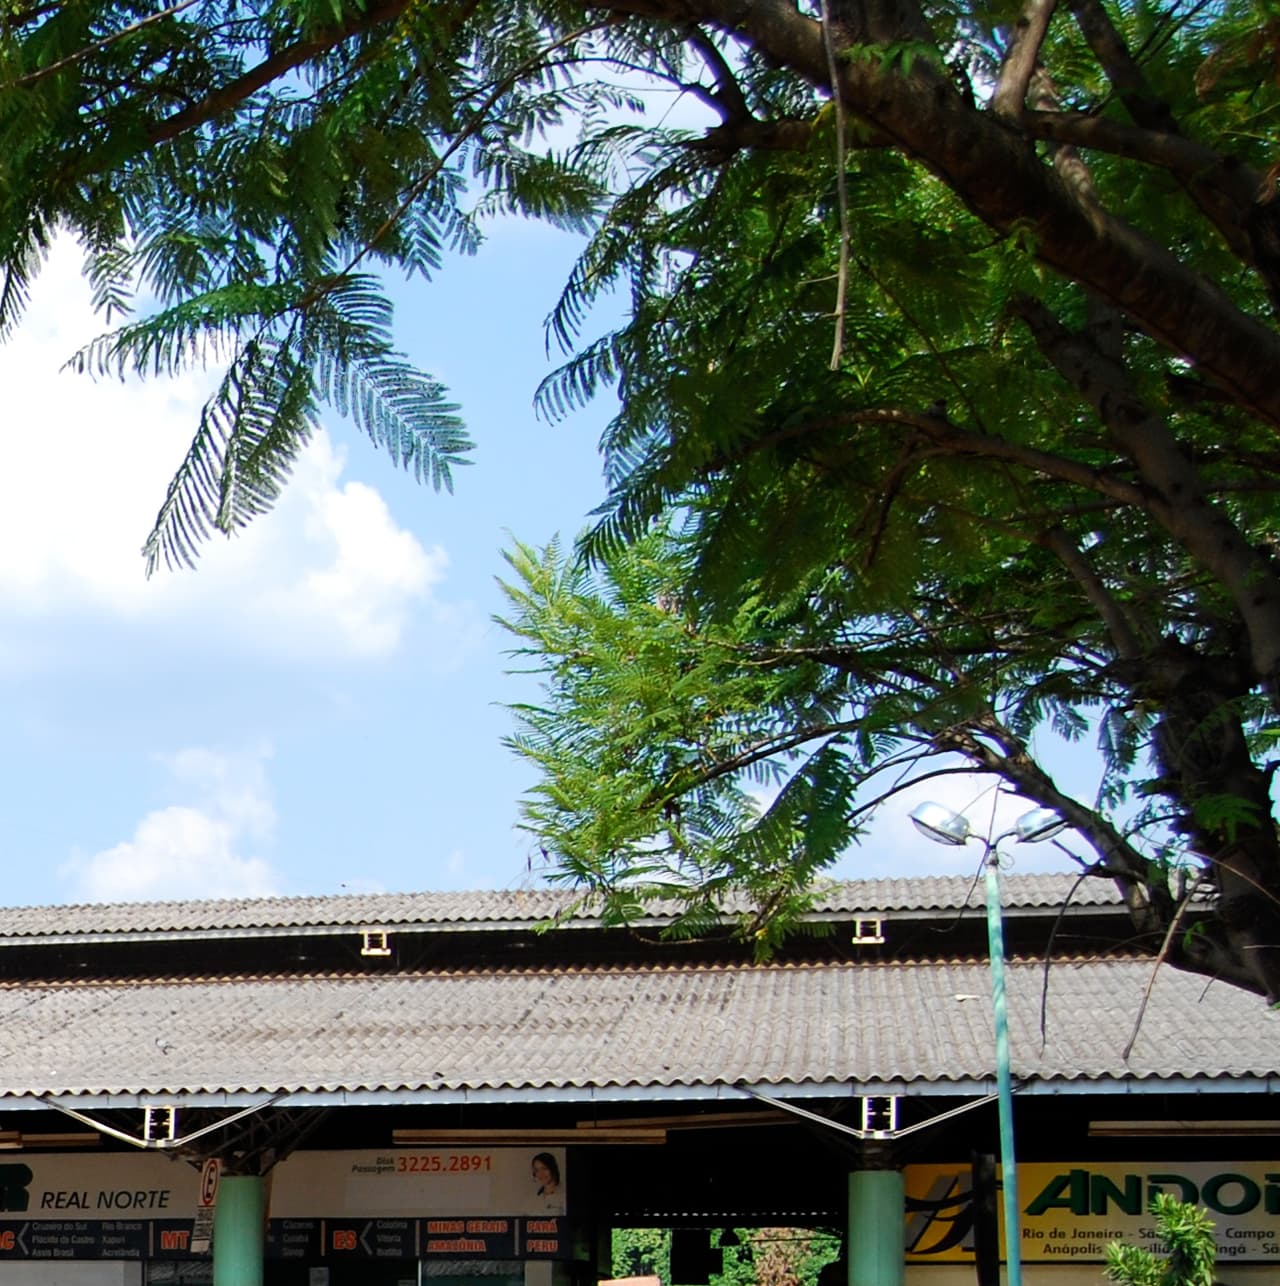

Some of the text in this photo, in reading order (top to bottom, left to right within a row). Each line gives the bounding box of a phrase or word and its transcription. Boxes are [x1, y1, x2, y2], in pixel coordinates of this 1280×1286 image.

[398, 1155, 493, 1173] 3225.2891
[40, 1189, 171, 1210] REAL NORTE
[427, 1220, 509, 1234] MINAS GERAIS
[526, 1218, 559, 1234] PARÁ
[161, 1230, 190, 1250] MT
[333, 1230, 358, 1250] ES
[1022, 1227, 1046, 1239] Rio
[1048, 1227, 1066, 1239] de
[1070, 1227, 1123, 1239] Janeiro
[1225, 1227, 1275, 1242] Campo
[526, 1239, 559, 1253] PERU
[1042, 1242, 1103, 1257] Anápolis
